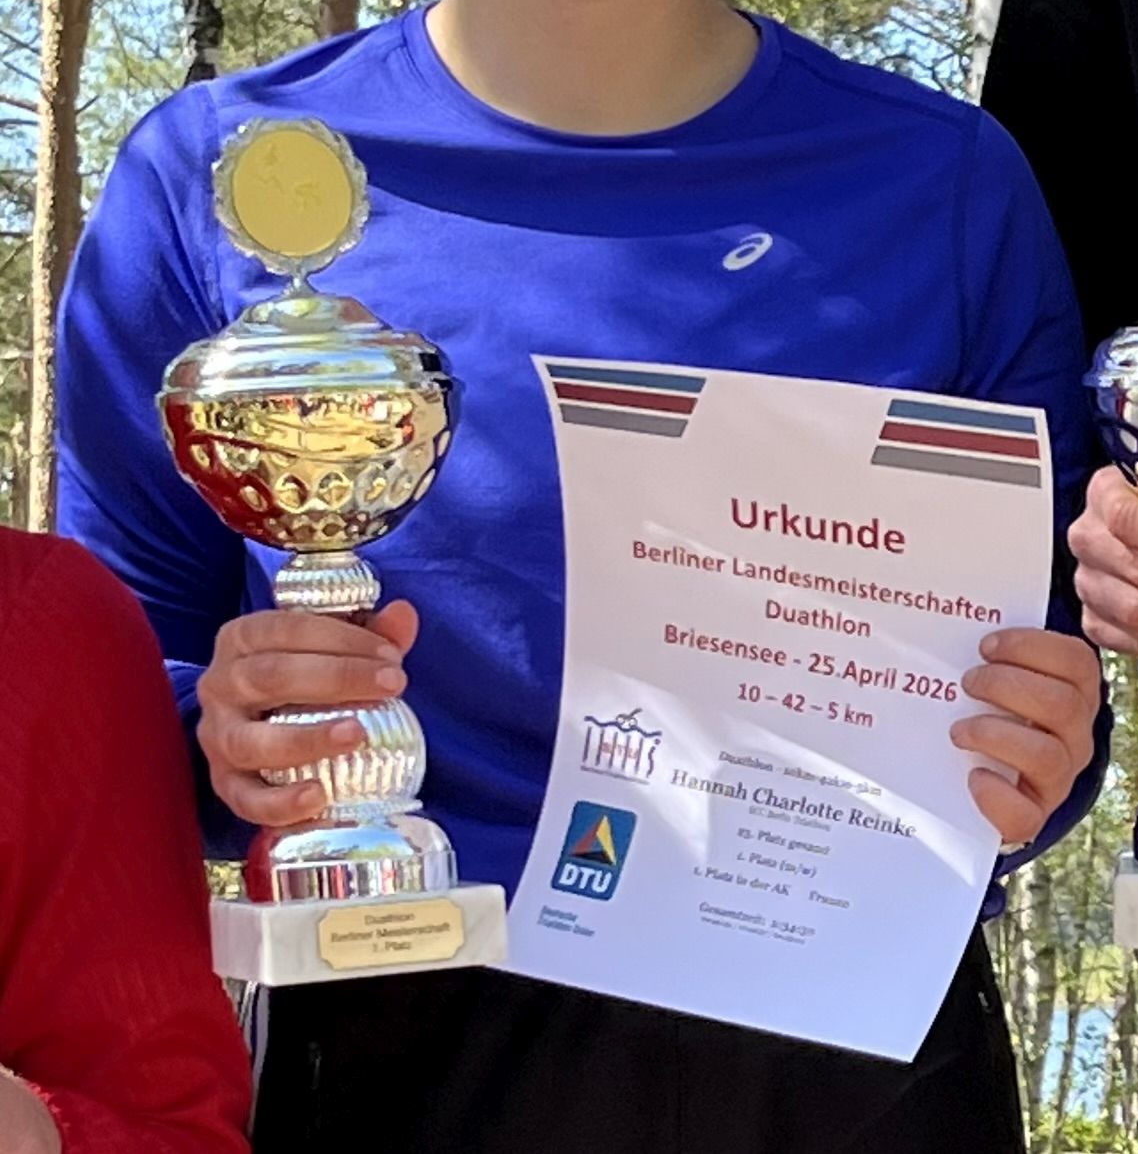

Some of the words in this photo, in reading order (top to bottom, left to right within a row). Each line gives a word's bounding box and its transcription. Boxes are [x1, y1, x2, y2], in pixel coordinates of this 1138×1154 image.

[731, 497, 905, 554] Urkunde
[632, 540, 725, 573] Berliner
[732, 556, 1002, 624] Landesmeisterschaften
[765, 599, 871, 638] Duathlon
[664, 623, 787, 666] Briesensee
[808, 653, 898, 688] 25.April
[902, 672, 957, 702] 2026
[738, 683, 760, 702] 10
[782, 693, 805, 712] 42
[828, 701, 838, 720] 5
[844, 704, 873, 727] km
[670, 768, 748, 801] Hannah
[752, 786, 844, 822] Charlotte
[848, 807, 917, 839] Reinke
[558, 862, 612, 893] DTU
[772, 883, 790, 897] AK
